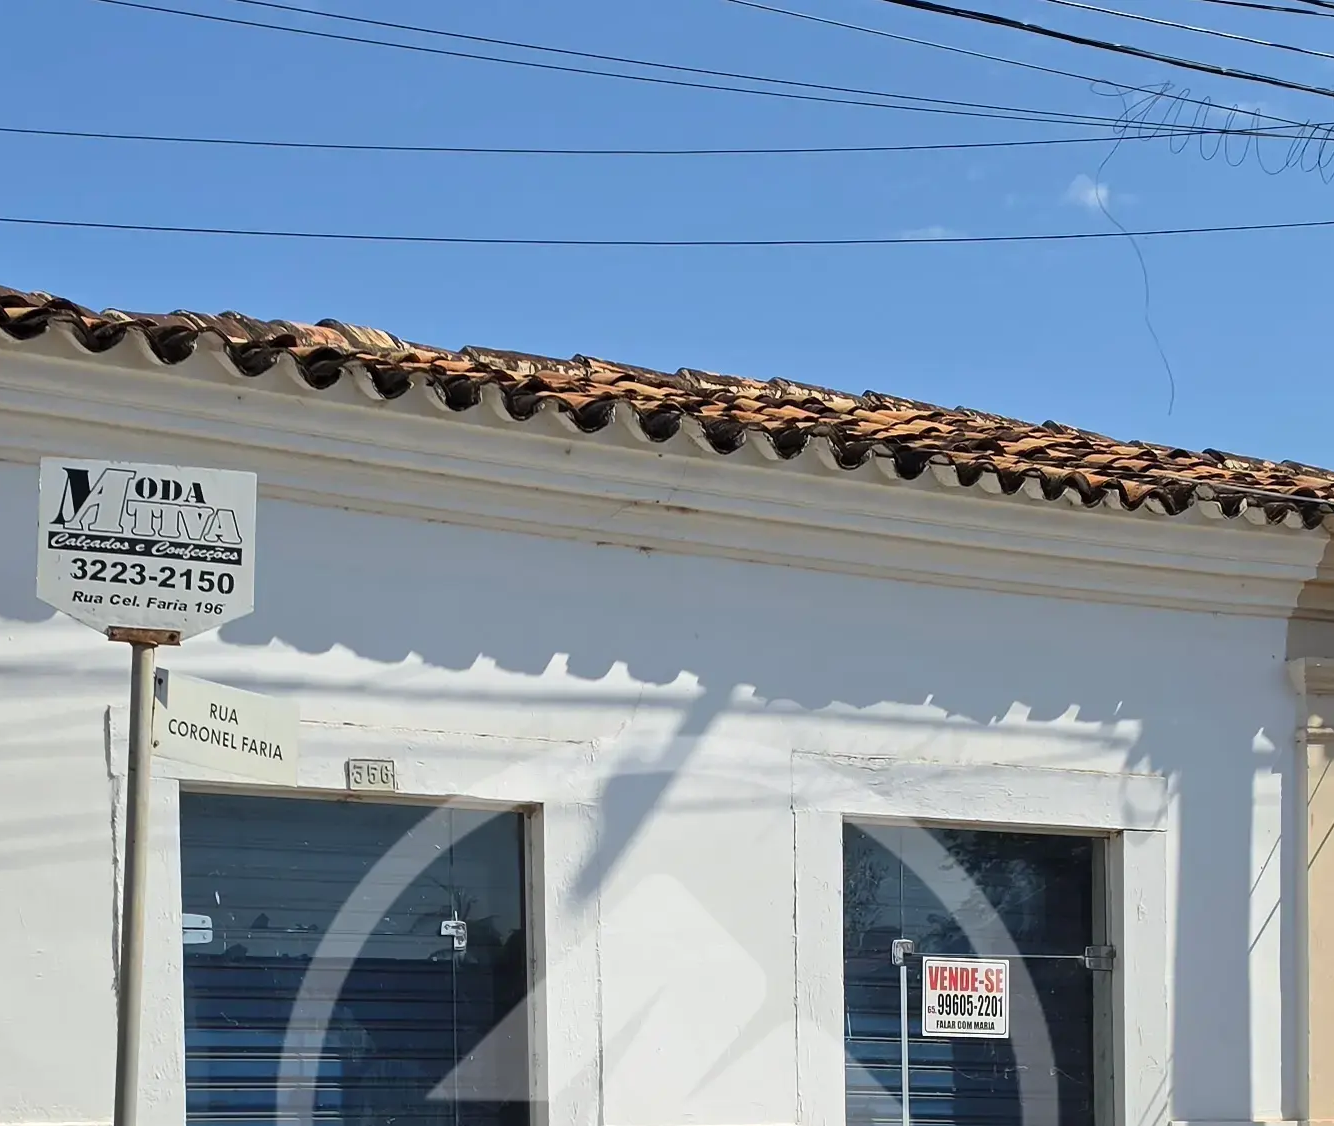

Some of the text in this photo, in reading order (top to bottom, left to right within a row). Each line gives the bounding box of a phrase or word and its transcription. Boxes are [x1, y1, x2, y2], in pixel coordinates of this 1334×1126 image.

[63, 468, 242, 544] ATIVA
[51, 532, 239, 561] Calçados e Confecções
[70, 558, 234, 595] 3223-2150
[72, 591, 224, 615] Rua Cel. Faria 196
[210, 703, 239, 725] RUA
[168, 719, 283, 761] CORONEL FARIA
[928, 966, 1004, 993] VENDE-SE
[938, 994, 1003, 1017] 99605-2201
[936, 1020, 995, 1030] FALAR COM MARIA
